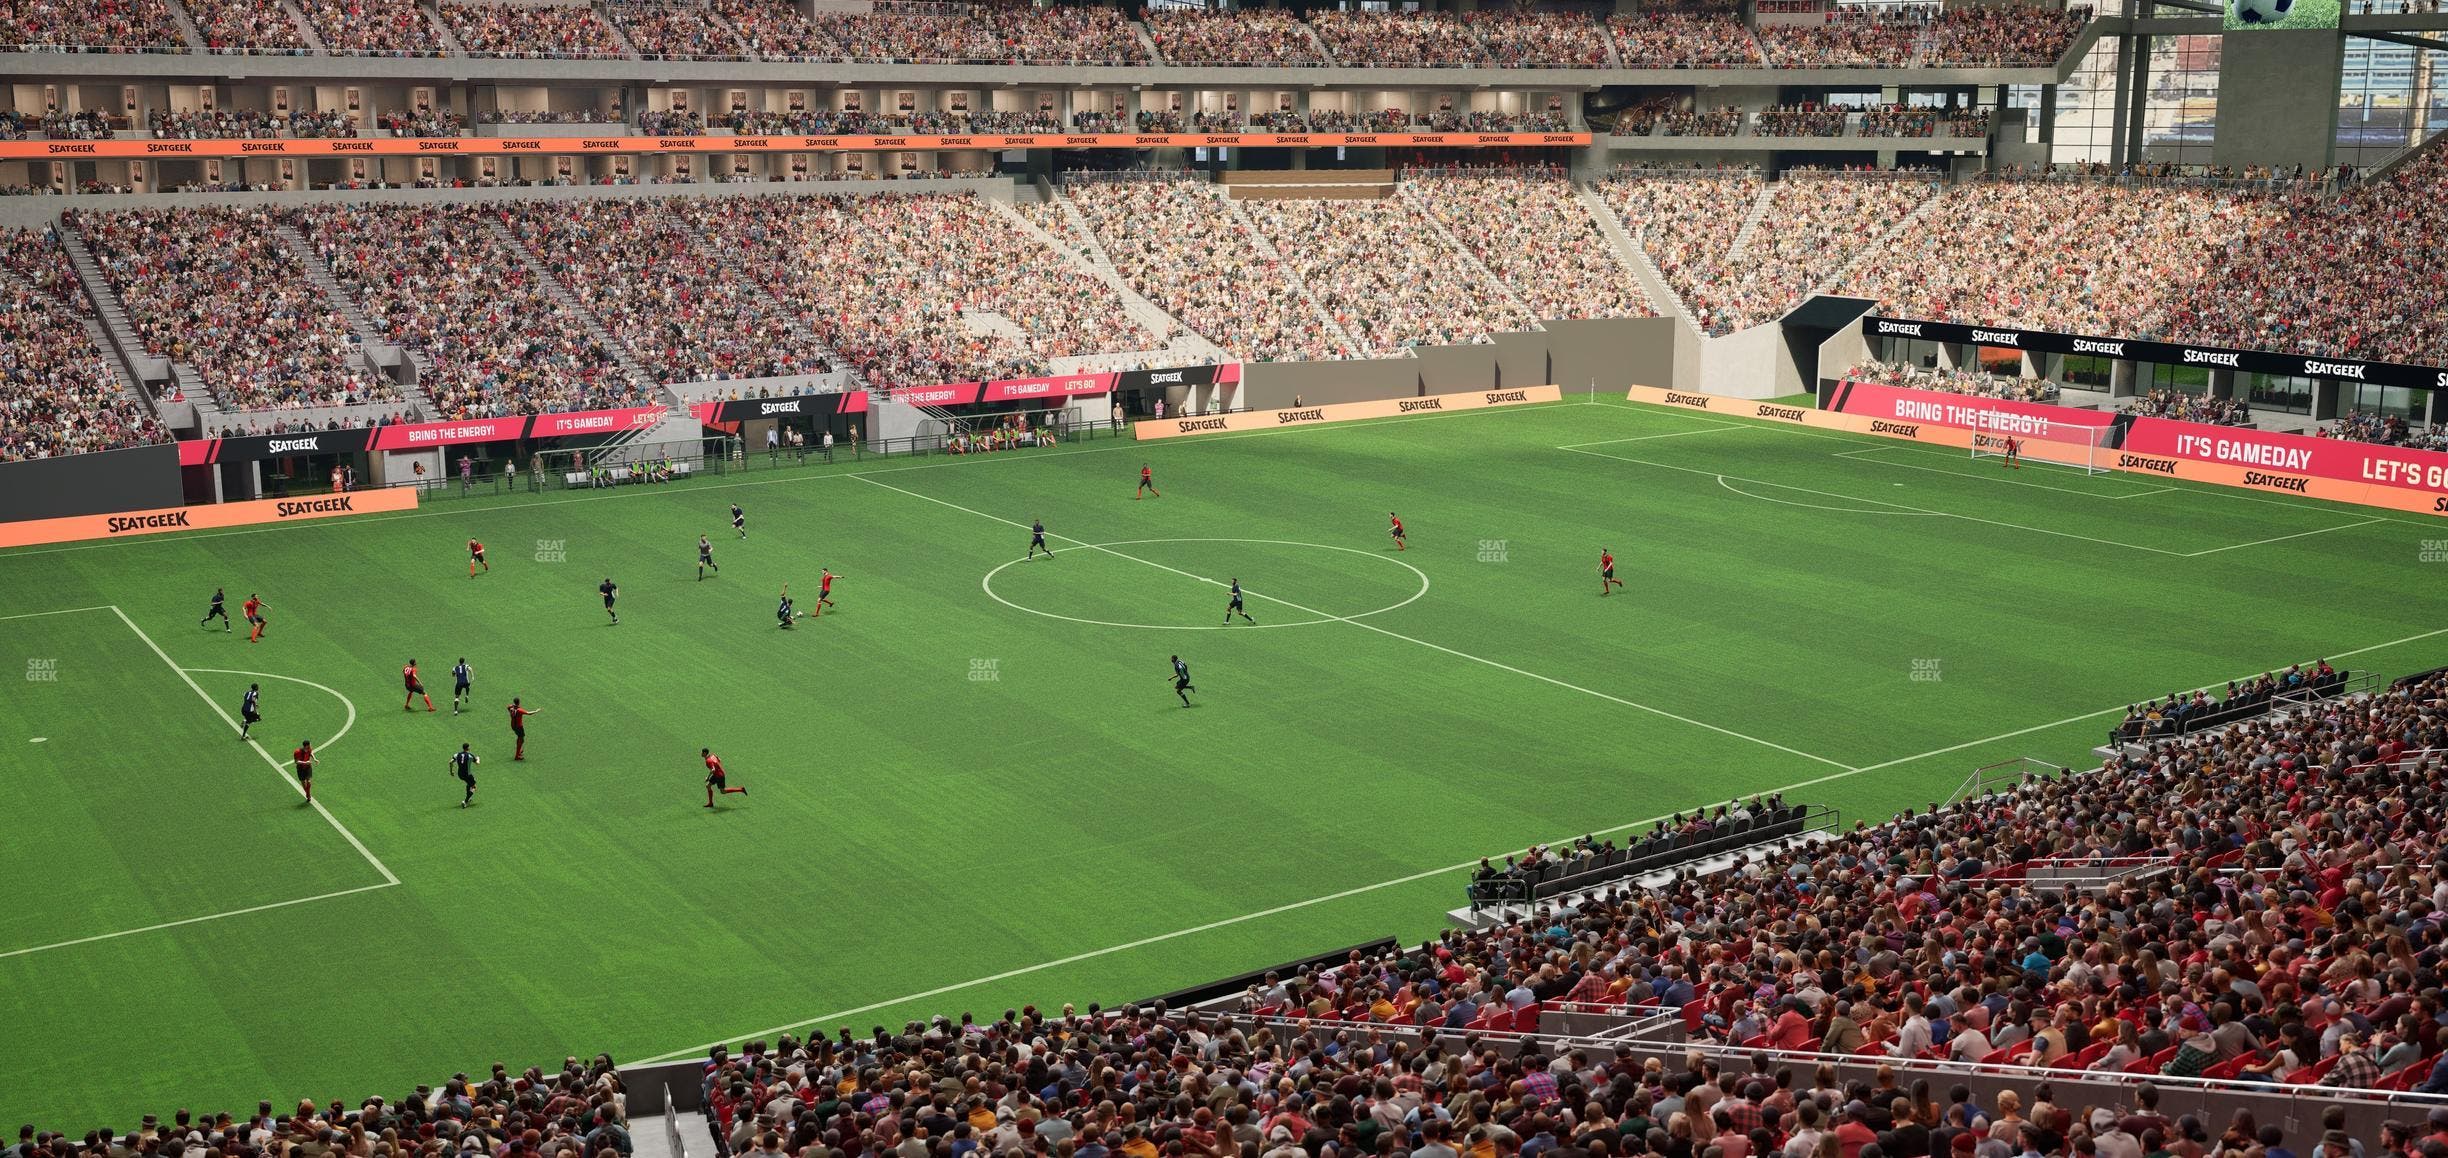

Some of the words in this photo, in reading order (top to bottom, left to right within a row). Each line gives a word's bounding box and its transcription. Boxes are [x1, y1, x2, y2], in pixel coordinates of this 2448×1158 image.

[48, 144, 96, 154] SEATGEEK
[147, 144, 193, 153] SEATGEEK
[241, 143, 285, 152] SEATGEEK
[332, 142, 374, 151] SEATGEEK
[419, 141, 459, 151] SEATGEEK
[502, 141, 541, 150] SEATGEEK
[582, 140, 620, 149] SEATGEEK
[659, 140, 695, 149] SEATGEEK
[734, 139, 768, 148] SEATGEEK
[1878, 320, 1922, 337] SEATGEEK
[1971, 329, 2019, 346] SEATGEEK
[2073, 338, 2125, 356] SEATGEEK
[2183, 349, 2239, 367] SEATGEEK
[2304, 360, 2365, 380] SEATGEEK
[1065, 380, 1083, 391] LET'S
[1150, 371, 1183, 385] SEATGEEK
[925, 389, 955, 401] ENERGY!
[1018, 383, 1050, 394] GAMEDAY
[761, 400, 801, 415] SEATGEEK
[1178, 417, 1229, 434] SEATGEEK
[1277, 408, 1325, 424] SEATGEEK
[1398, 398, 1442, 413] SEATGEEK
[1486, 390, 1528, 405] SEATGEEK
[556, 419, 573, 431] IT'S
[574, 416, 614, 430] GAMEDAY
[1895, 399, 1943, 422] BRING
[1946, 405, 1976, 426] THE
[1978, 409, 2048, 436] ENERGY!
[409, 429, 437, 442] BRING
[438, 428, 456, 440] THE
[457, 425, 495, 439] ENERGY!
[268, 436, 319, 454] SEATGEEK
[1664, 392, 1710, 409] SEATGEEK
[1756, 404, 1806, 422] SEATGEEK
[1869, 420, 1919, 438] SEATGEEK
[2117, 453, 2178, 475] SEATGEEK
[2243, 470, 2310, 493] SEATGEEK
[2176, 434, 2211, 458] IT'S
[2216, 438, 2313, 470] GAMEDAY
[2362, 457, 2422, 485] LET'S
[108, 510, 190, 533] SEATGEEK
[277, 495, 354, 518] SEATGEEK
